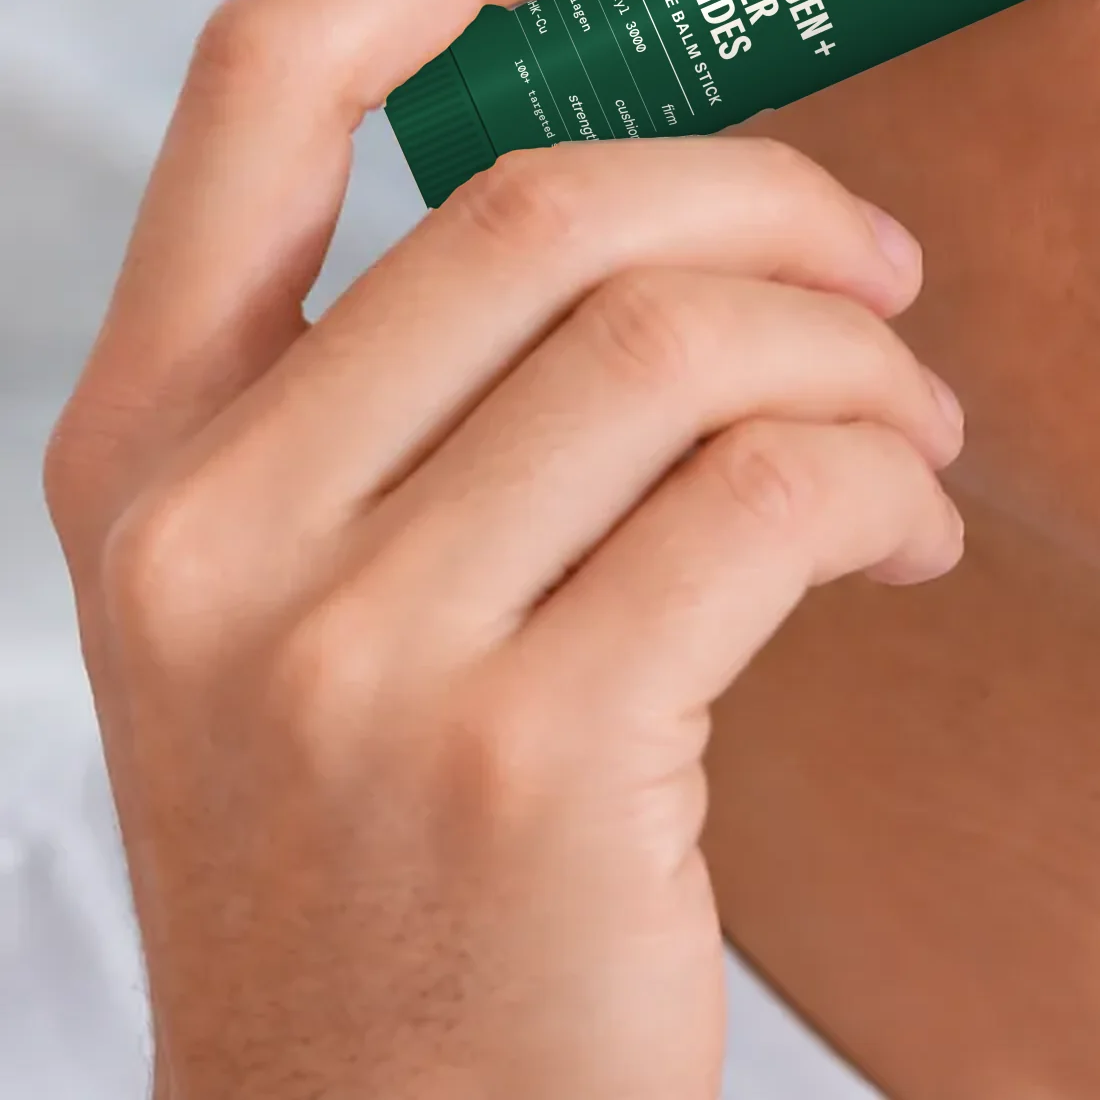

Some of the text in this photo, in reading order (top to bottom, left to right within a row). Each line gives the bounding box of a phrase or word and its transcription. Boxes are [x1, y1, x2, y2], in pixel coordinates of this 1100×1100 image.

[526, 0, 601, 142] HK-Cu strengt
[625, 20, 647, 53] 3000
[661, 103, 678, 126] firm
[671, 9, 702, 60] BALM
[694, 62, 722, 107] STICK
[814, 40, 836, 56] +
[514, 59, 556, 139] 100+ targeted
